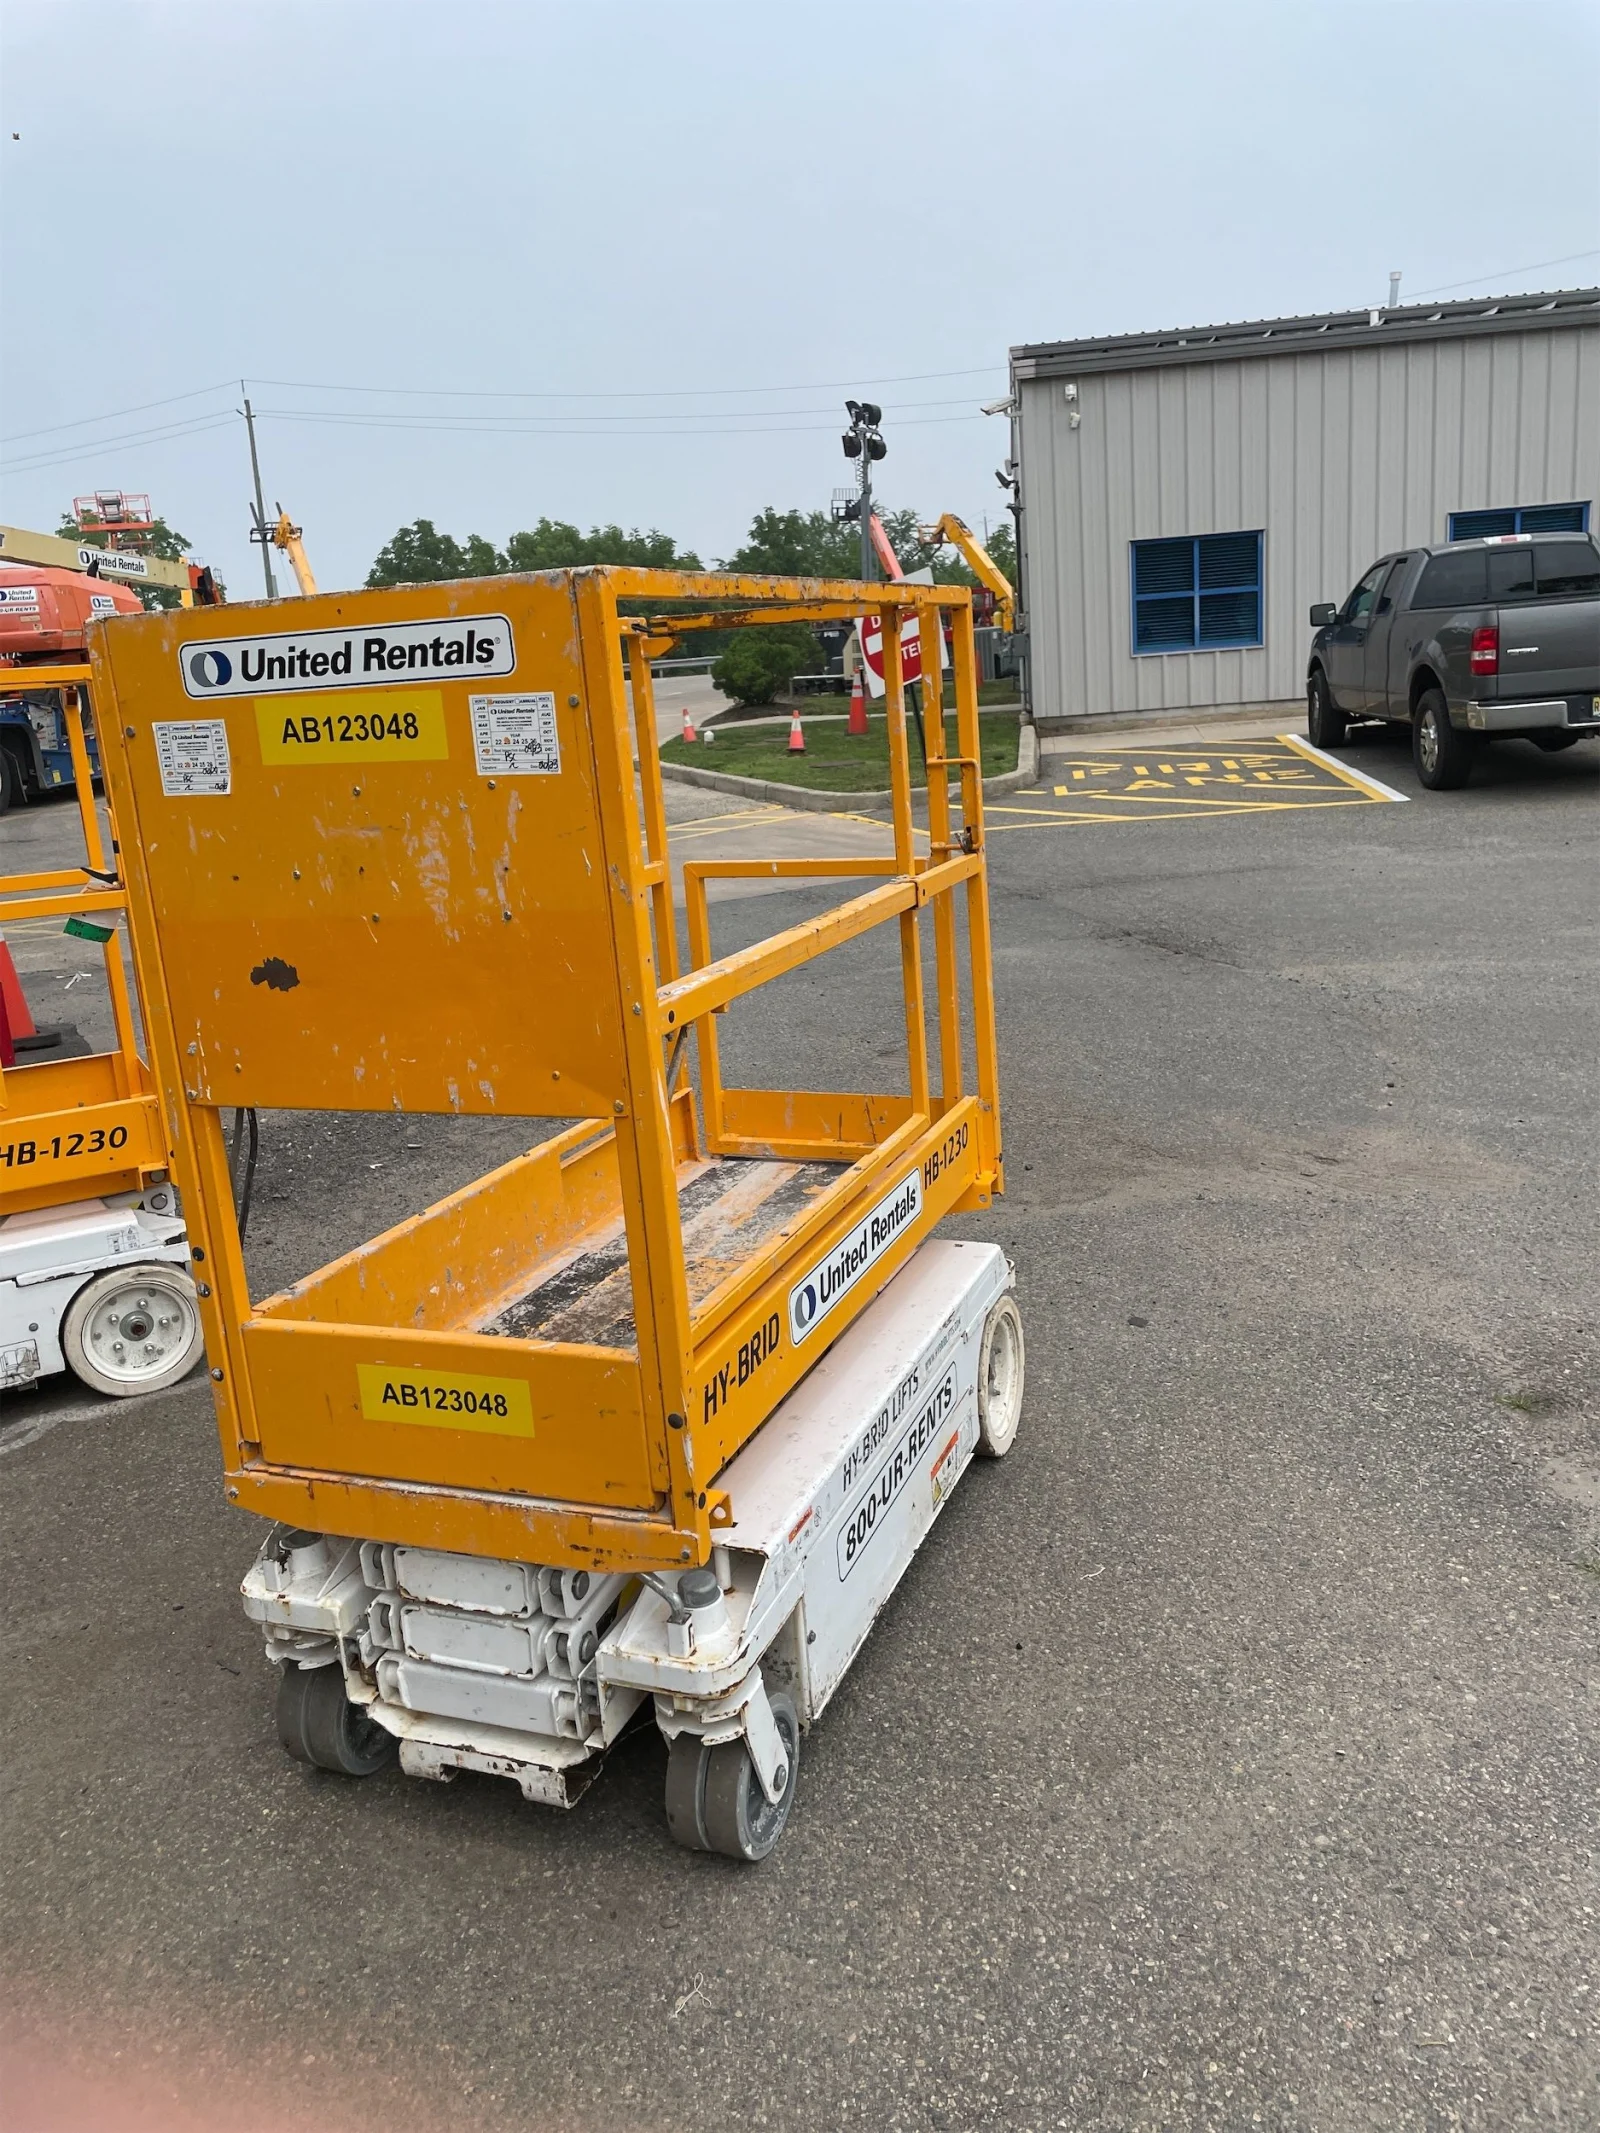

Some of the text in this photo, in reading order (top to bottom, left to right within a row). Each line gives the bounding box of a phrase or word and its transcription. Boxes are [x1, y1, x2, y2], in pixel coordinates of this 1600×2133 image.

[119, 558, 145, 573] Rentals
[241, 630, 495, 682] United Rentals
[282, 712, 419, 743] AB123048
[1053, 769, 1316, 797] LANE
[1064, 757, 1279, 780] FIRE
[0, 1126, 128, 1167] HB-1230
[924, 1122, 968, 1190] HB-1230
[820, 1185, 917, 1303] United Rentals
[704, 1312, 780, 1425] HY-BRID
[382, 1382, 508, 1417] AB123048
[843, 1366, 919, 1492] HY-BRID LIFTS
[846, 1376, 952, 1562] 800-UR-RENTS
